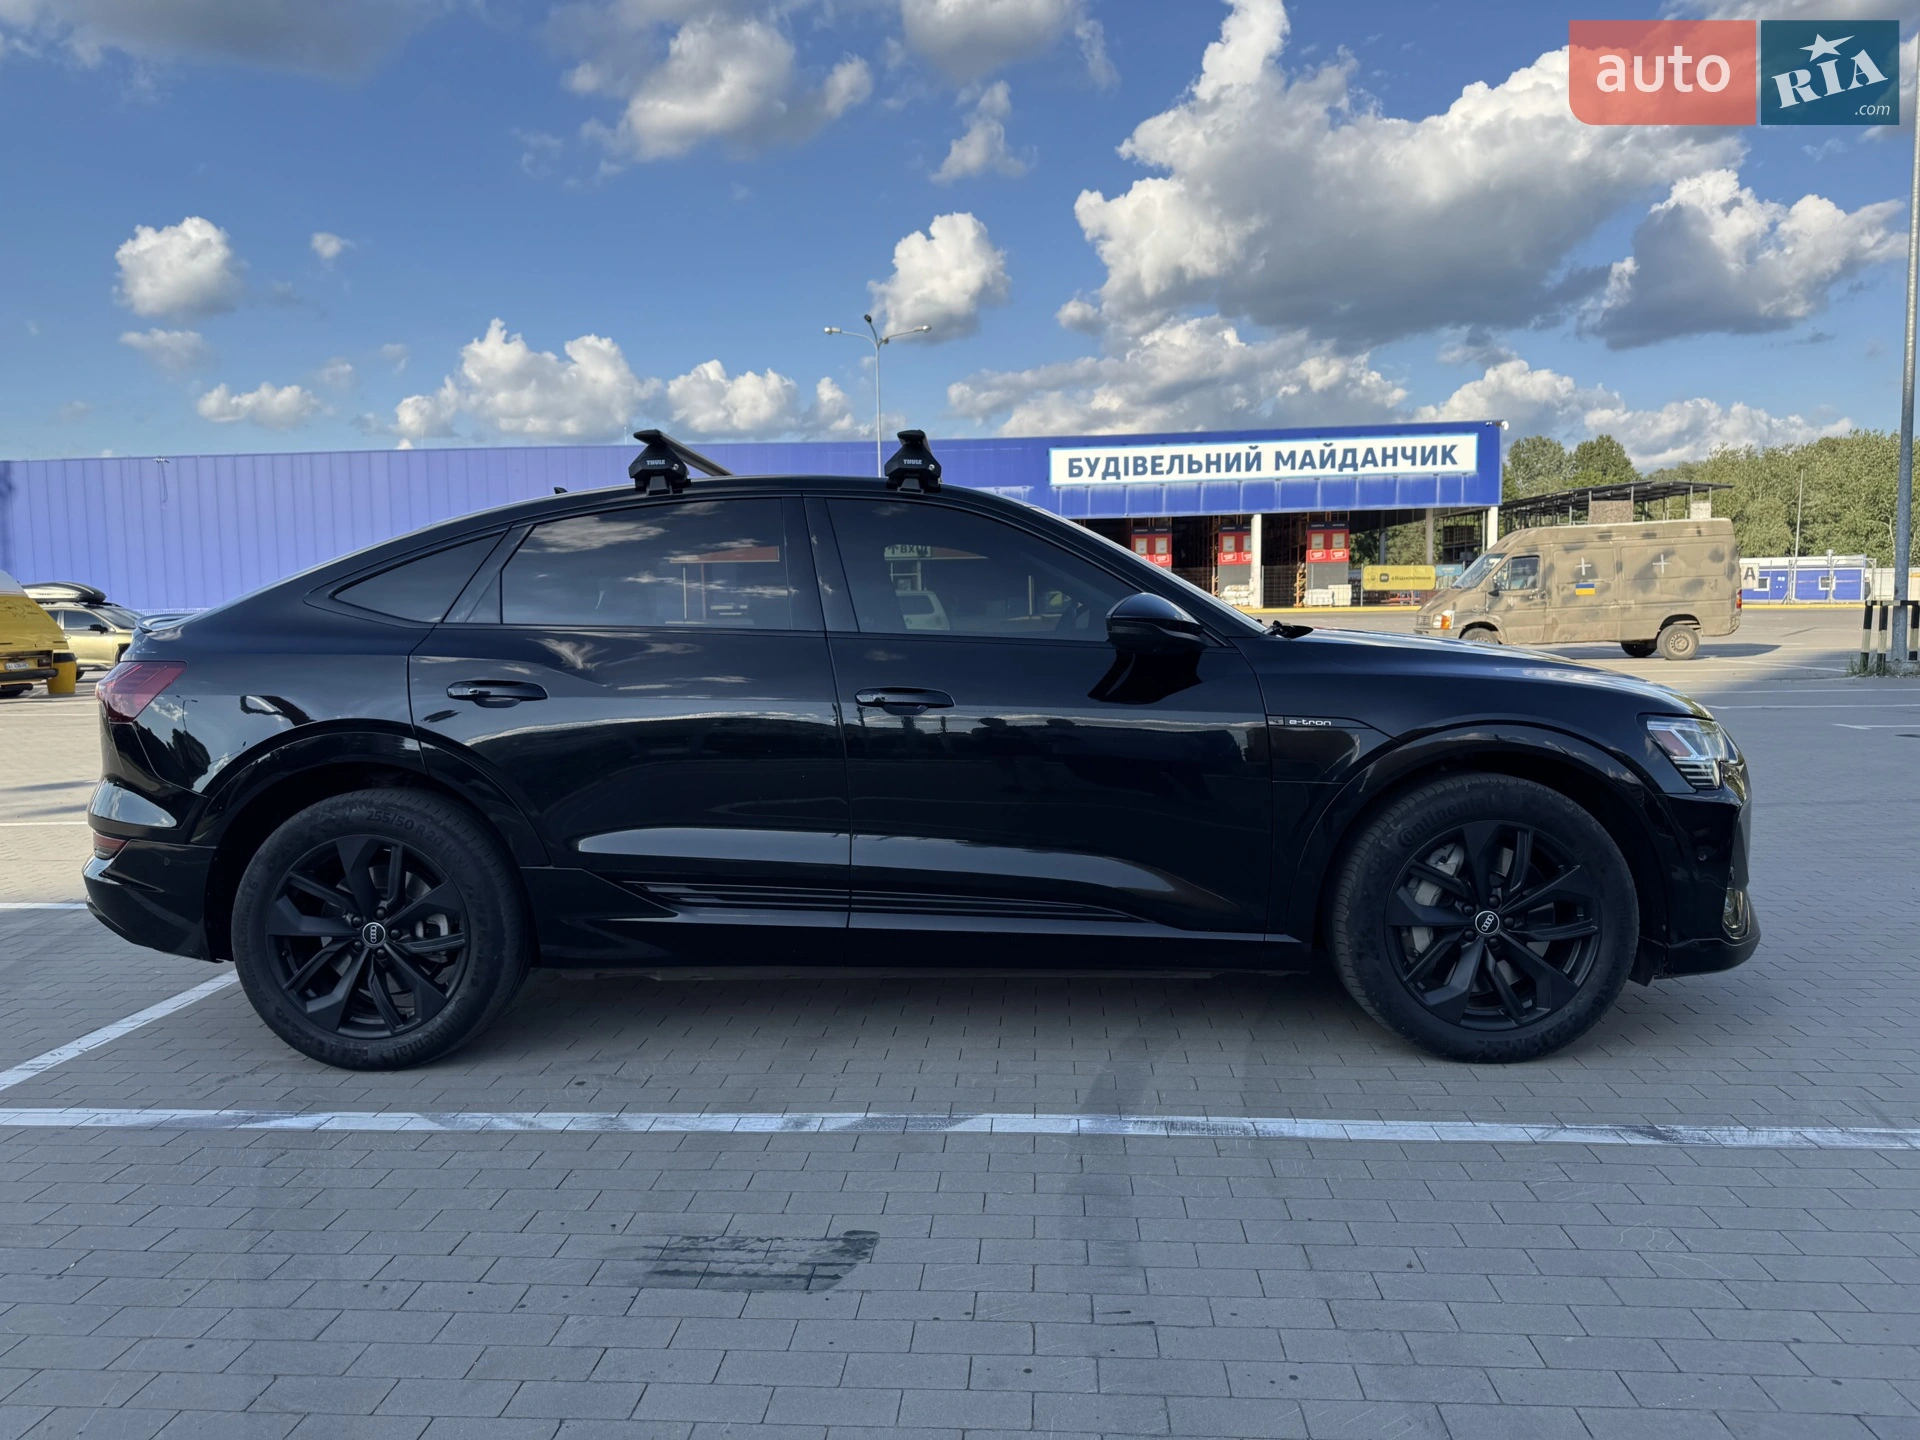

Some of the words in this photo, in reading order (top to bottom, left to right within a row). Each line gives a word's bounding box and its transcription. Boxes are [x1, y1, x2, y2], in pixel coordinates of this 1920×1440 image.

[1067, 446, 1263, 480] БУДІВЕЛЬНИЙ
[1274, 443, 1459, 471] МАЙДАНЧИК
[366, 810, 415, 830] 255/50
